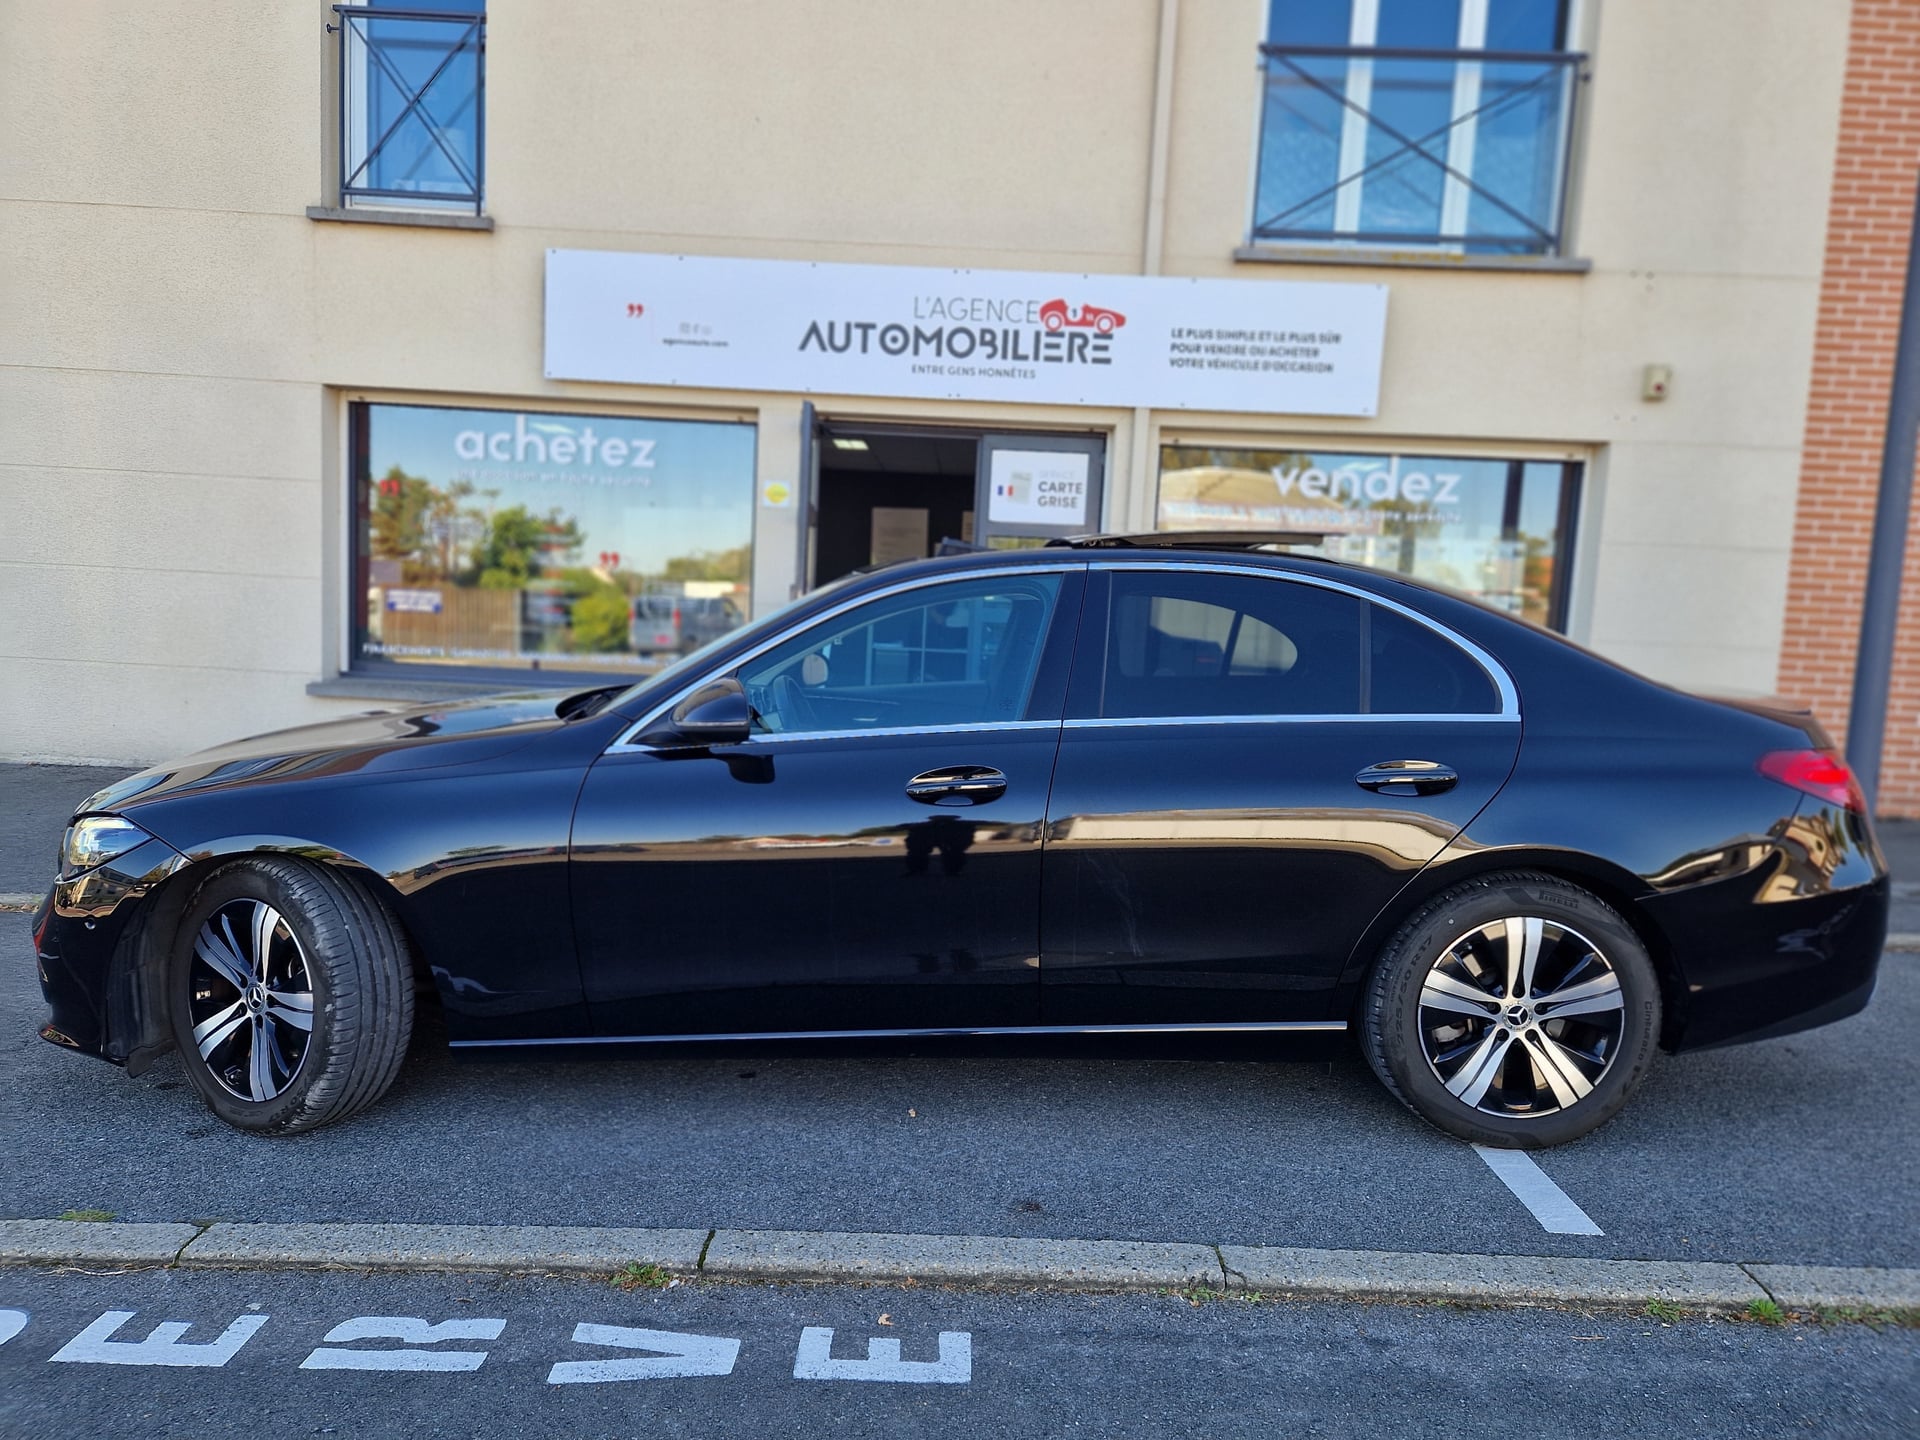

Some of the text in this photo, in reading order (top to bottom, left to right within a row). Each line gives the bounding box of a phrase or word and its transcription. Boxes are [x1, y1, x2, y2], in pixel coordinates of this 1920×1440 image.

[914, 296, 1040, 324] L'AGENCE
[1171, 328, 1183, 339] LE
[1186, 328, 1213, 340] PLUS
[1216, 330, 1256, 342] SIMPLE
[1258, 331, 1272, 342] ET
[1274, 332, 1286, 342] LE
[1289, 332, 1316, 344] PLUS
[1170, 343, 1320, 358] POUR VENDRE OU ACHETER
[912, 364, 1036, 379] ENTRE GENS HONNÊTES
[1169, 358, 1204, 369] VOTRE
[1262, 361, 1334, 373] D'OCCASION
[455, 415, 656, 468] achetez
[1271, 456, 1461, 503] vendez
[1038, 481, 1083, 494] CARTE
[1037, 495, 1078, 509] GRISE
